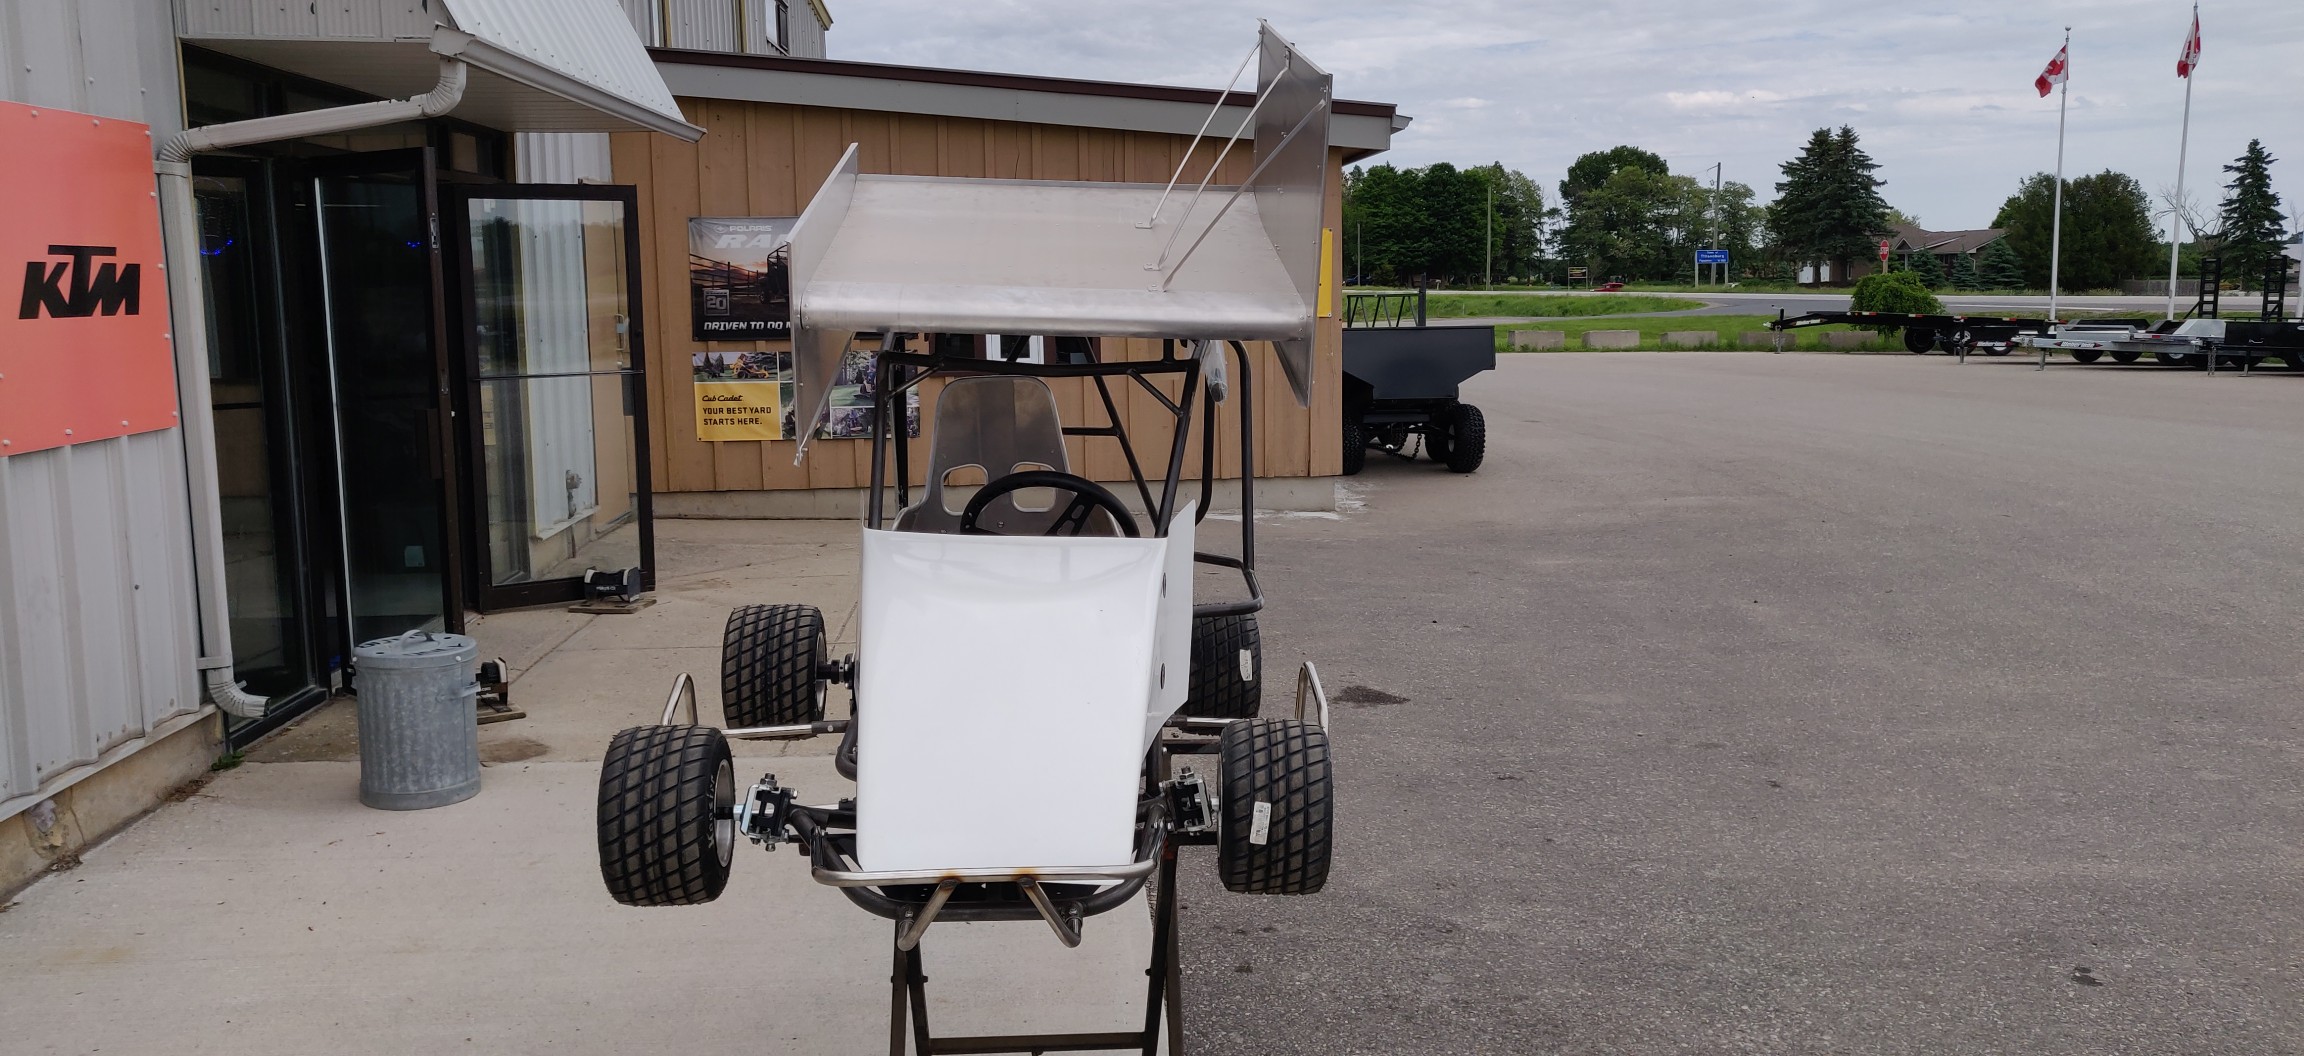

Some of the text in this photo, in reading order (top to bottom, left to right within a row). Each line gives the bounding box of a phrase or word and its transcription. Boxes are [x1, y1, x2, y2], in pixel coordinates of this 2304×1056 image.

[729, 225, 773, 233] POLARIS
[19, 245, 140, 319] KTM
[706, 296, 727, 310] 20
[703, 321, 748, 331] DRIVEN
[749, 321, 765, 330] TO
[767, 321, 783, 330] DO
[717, 394, 743, 402] Cadet
[703, 406, 772, 415] YOUR BEST YARD
[703, 417, 763, 426] STARTS HERE.
